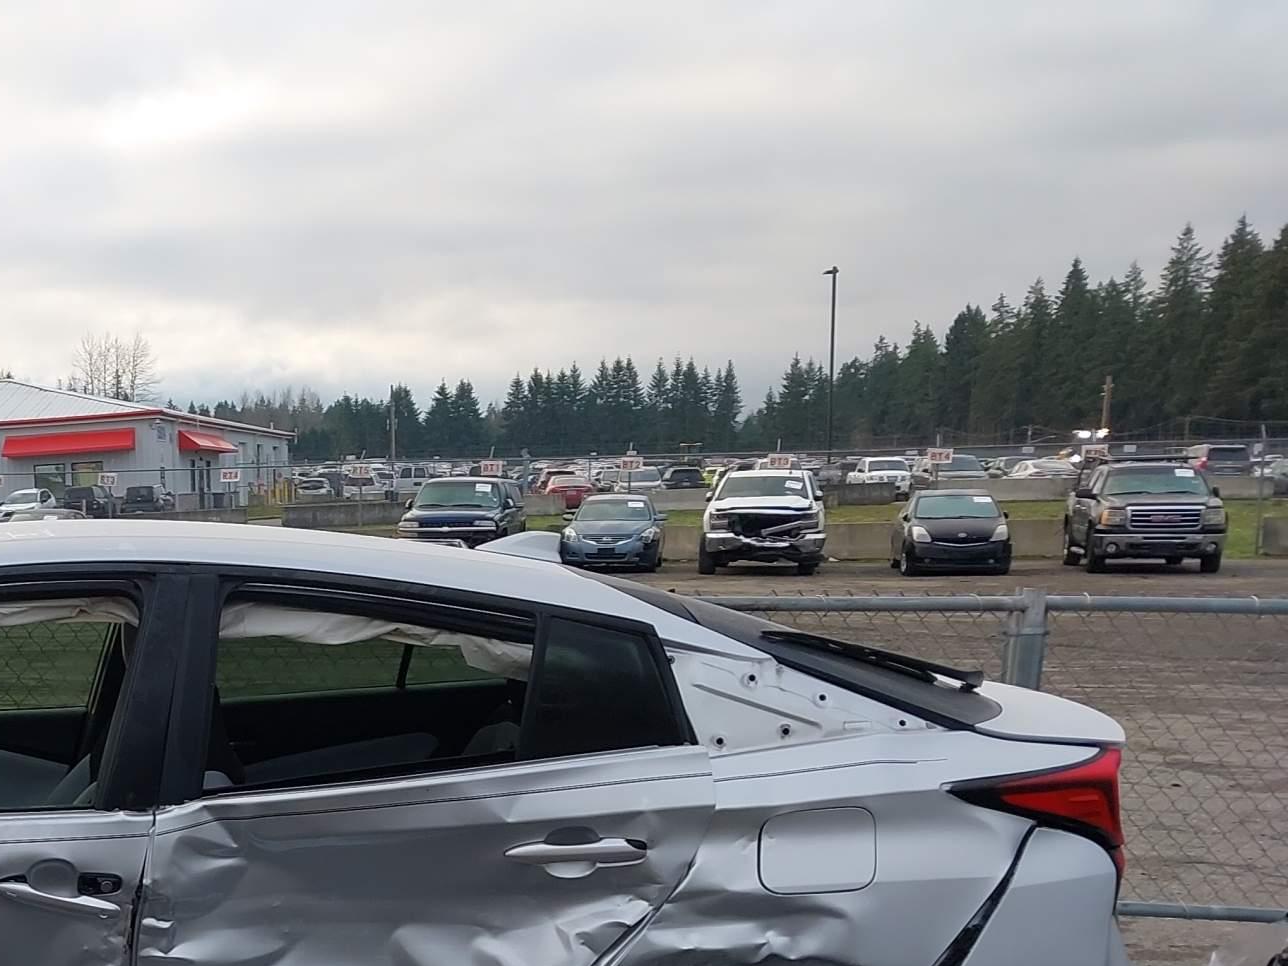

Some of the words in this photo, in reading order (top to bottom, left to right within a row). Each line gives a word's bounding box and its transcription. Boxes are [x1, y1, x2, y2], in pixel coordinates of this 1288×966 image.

[930, 452, 950, 461] BT4
[623, 460, 641, 469] BT2
[770, 457, 789, 466] BT3
